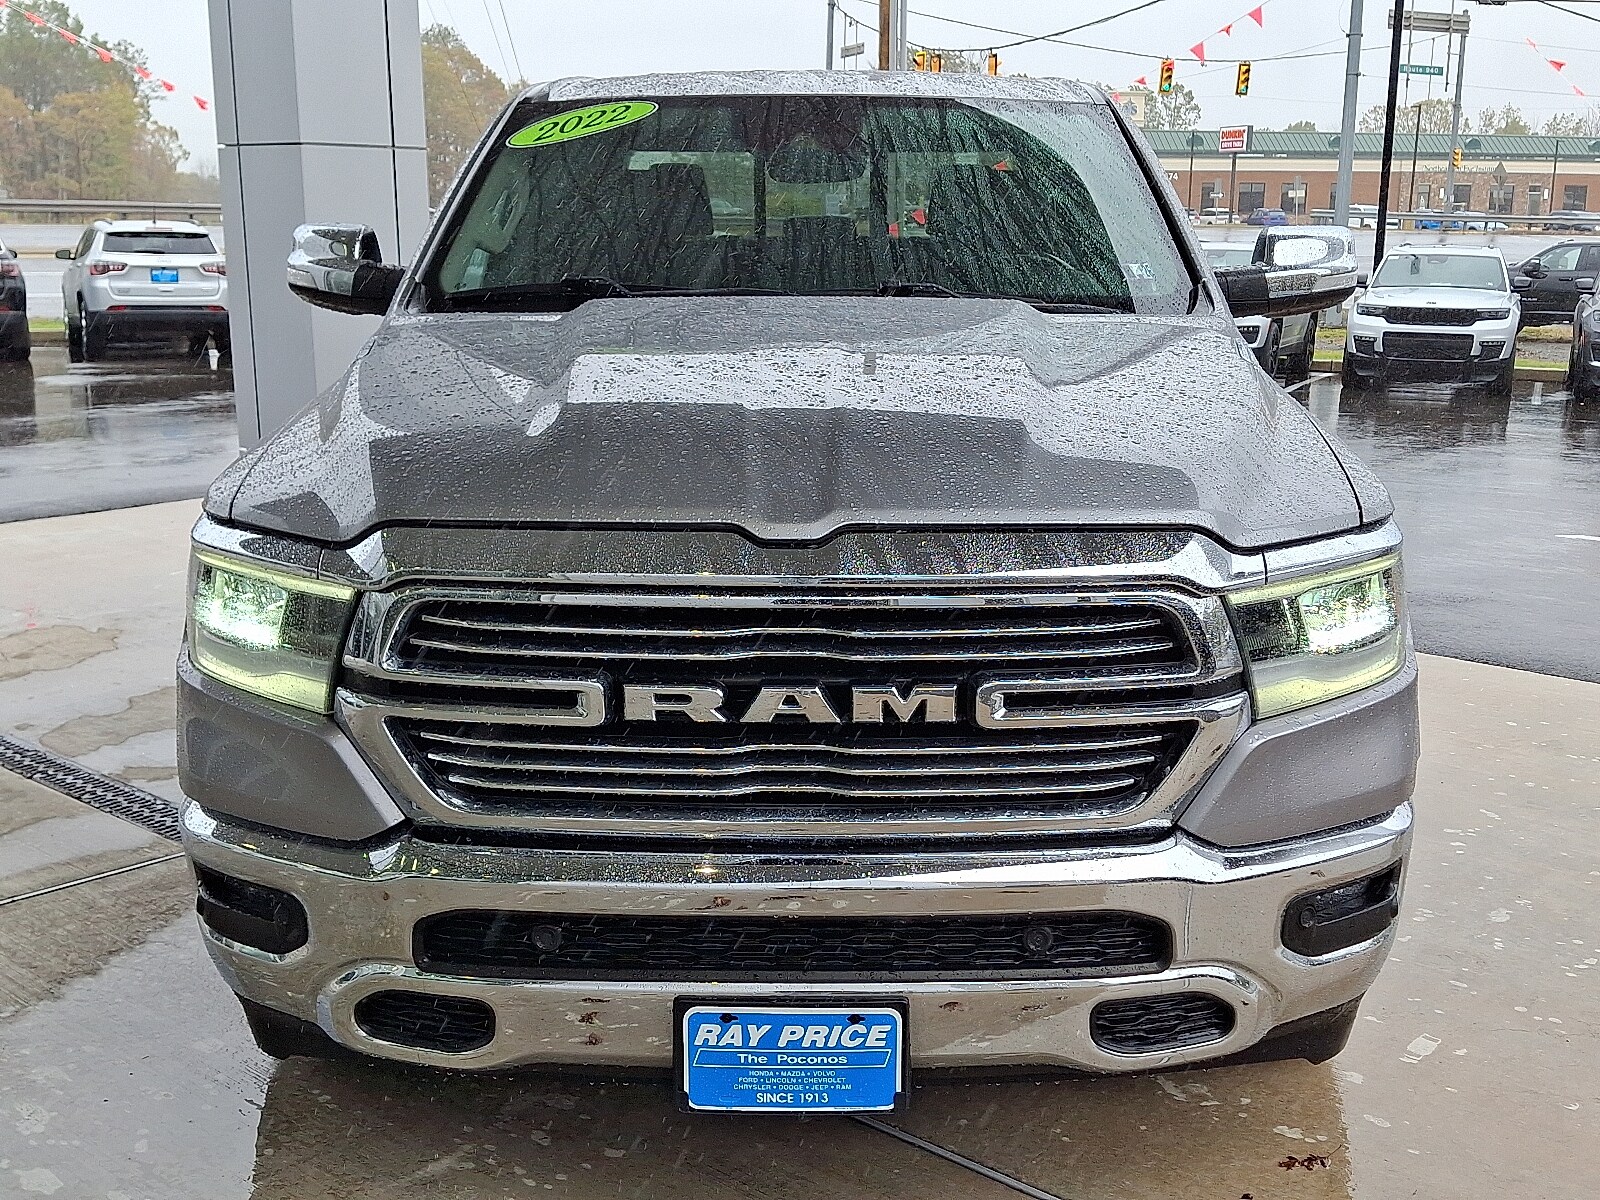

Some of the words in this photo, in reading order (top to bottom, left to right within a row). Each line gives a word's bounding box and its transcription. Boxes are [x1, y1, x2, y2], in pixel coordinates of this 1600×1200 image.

[532, 104, 632, 143] 2022
[623, 684, 958, 723] RAM
[693, 1023, 772, 1047] RAY
[777, 1024, 892, 1048] PRICE
[737, 1053, 768, 1065] The
[777, 1053, 848, 1065] Poconos
[756, 1092, 794, 1104] SINCE
[799, 1092, 829, 1104] 1913
